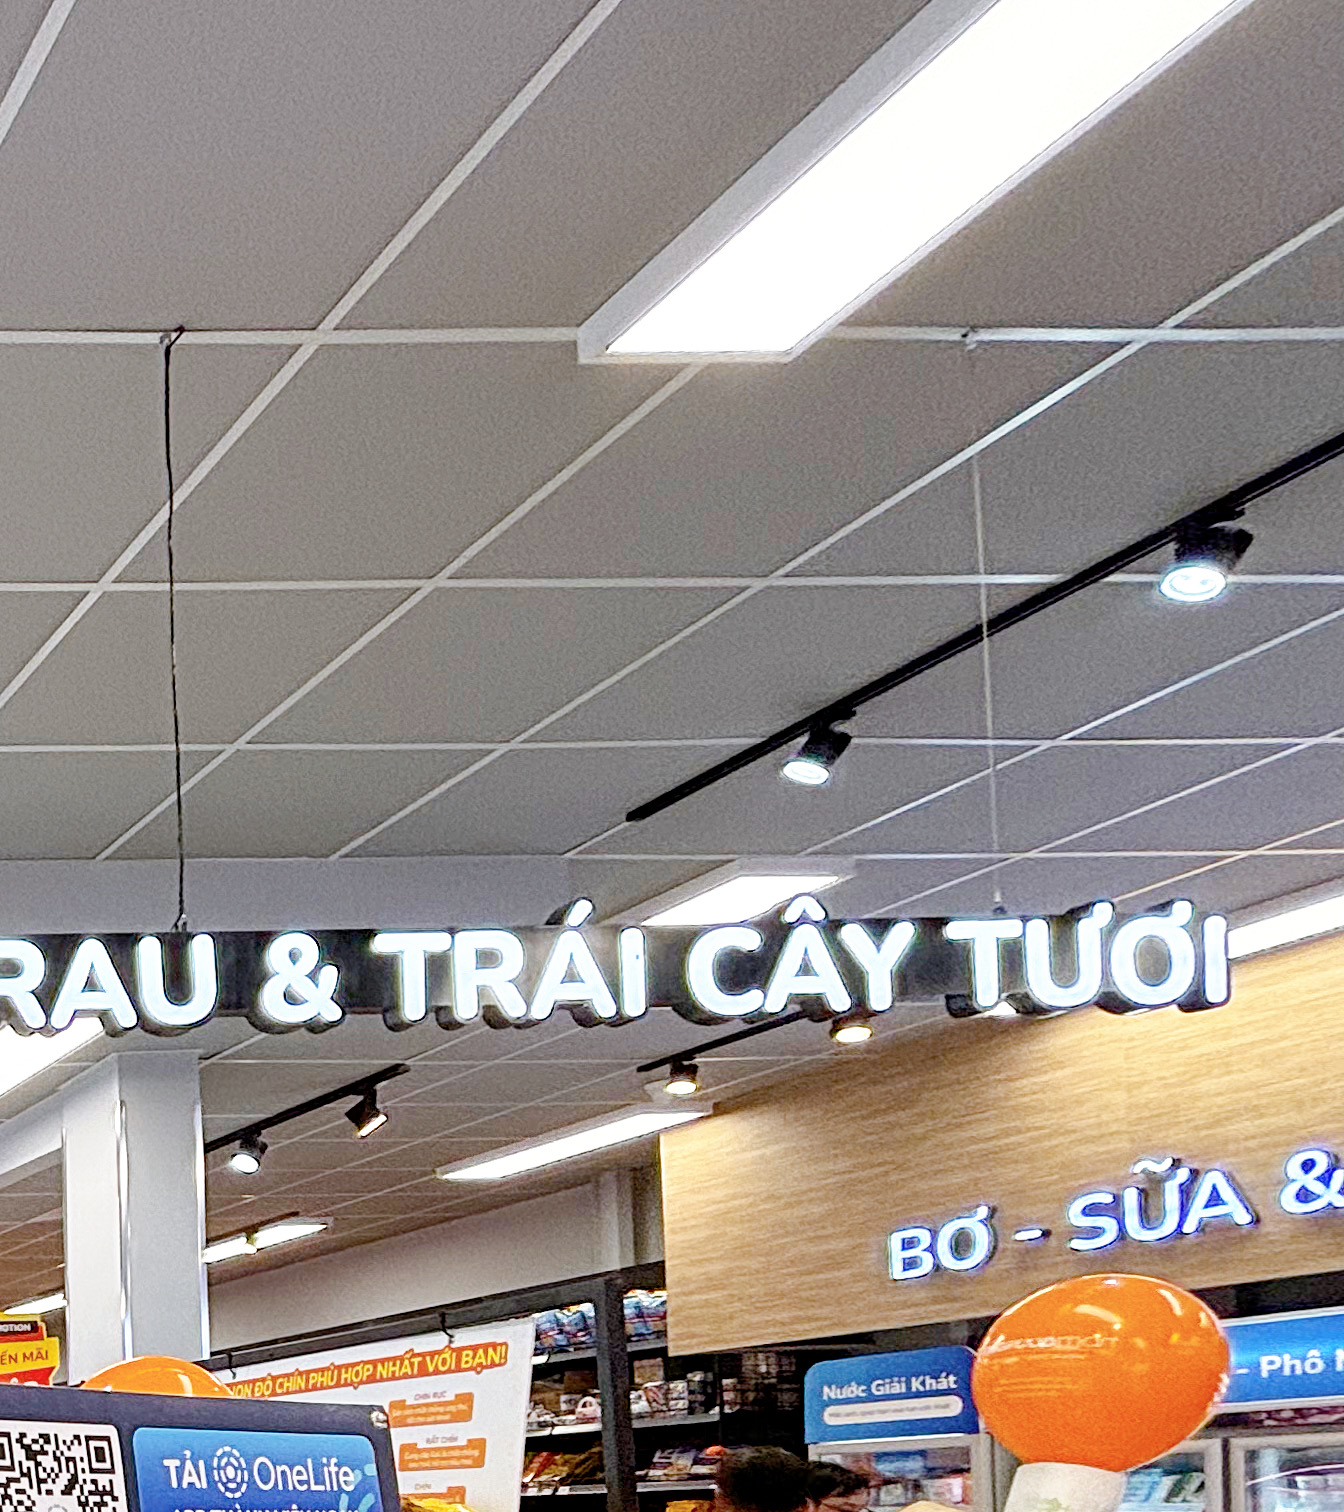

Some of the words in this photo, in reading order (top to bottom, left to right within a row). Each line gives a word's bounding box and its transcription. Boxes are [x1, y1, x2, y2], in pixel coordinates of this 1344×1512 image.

[260, 931, 343, 1025] &
[371, 898, 648, 1021] TRÁI
[688, 894, 916, 1016] CÂY
[944, 899, 1230, 1010] TƯƠI
[889, 1205, 995, 1281] BƠ
[1068, 1155, 1255, 1252] SỮA
[1279, 1148, 1344, 1216] &
[22, 1348, 49, 1364] MÃI
[275, 1369, 306, 1393] CHÍN
[309, 1363, 337, 1389] PHÙ
[340, 1365, 373, 1390] HỢP
[377, 1350, 422, 1379] NHẤT
[426, 1346, 456, 1372] VỚI
[461, 1344, 507, 1373] BẠN!
[1259, 1349, 1326, 1378] Phô
[822, 1382, 867, 1401] Nước
[871, 1377, 906, 1396] Giải
[911, 1372, 958, 1393] Khát
[163, 1450, 207, 1489] TẢI
[253, 1456, 354, 1491] OneLife
